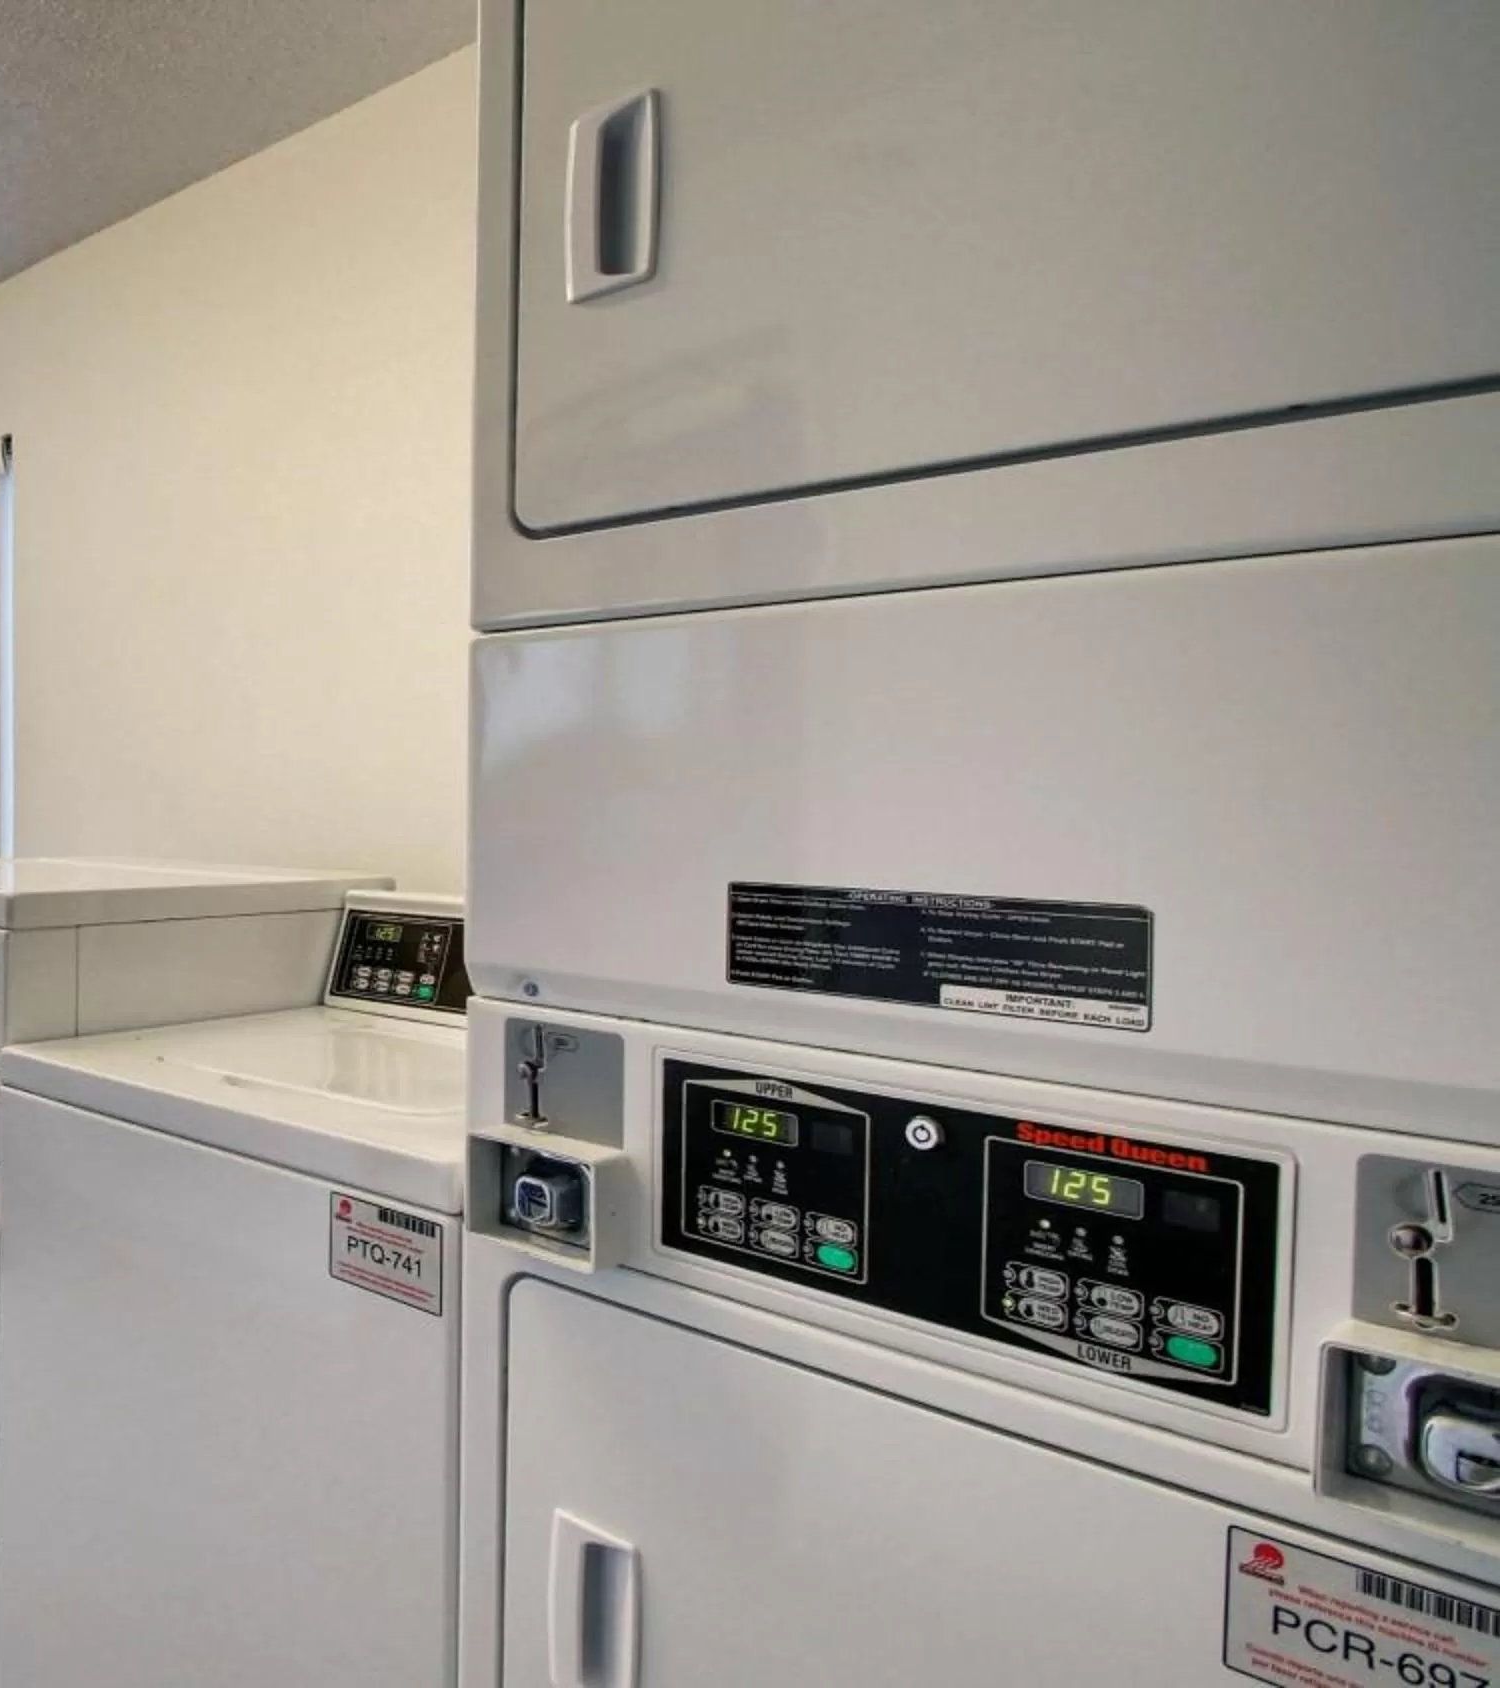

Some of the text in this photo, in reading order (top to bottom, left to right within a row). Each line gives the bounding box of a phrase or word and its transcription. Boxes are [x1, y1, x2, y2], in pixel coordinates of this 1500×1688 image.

[944, 997, 975, 1008] CLEAN
[1002, 1004, 1035, 1015] FILTER
[1039, 1008, 1078, 1019] BEFORE
[1083, 1013, 1112, 1023] EACH
[1116, 1017, 1145, 1027] LOAD
[755, 1081, 793, 1100] UPPER
[730, 1108, 778, 1138] 125
[1016, 1120, 1209, 1172] Speed Queen
[1051, 1168, 1112, 1205] 125
[347, 1235, 422, 1277] PTQ-741
[1077, 1343, 1132, 1372] LOWER
